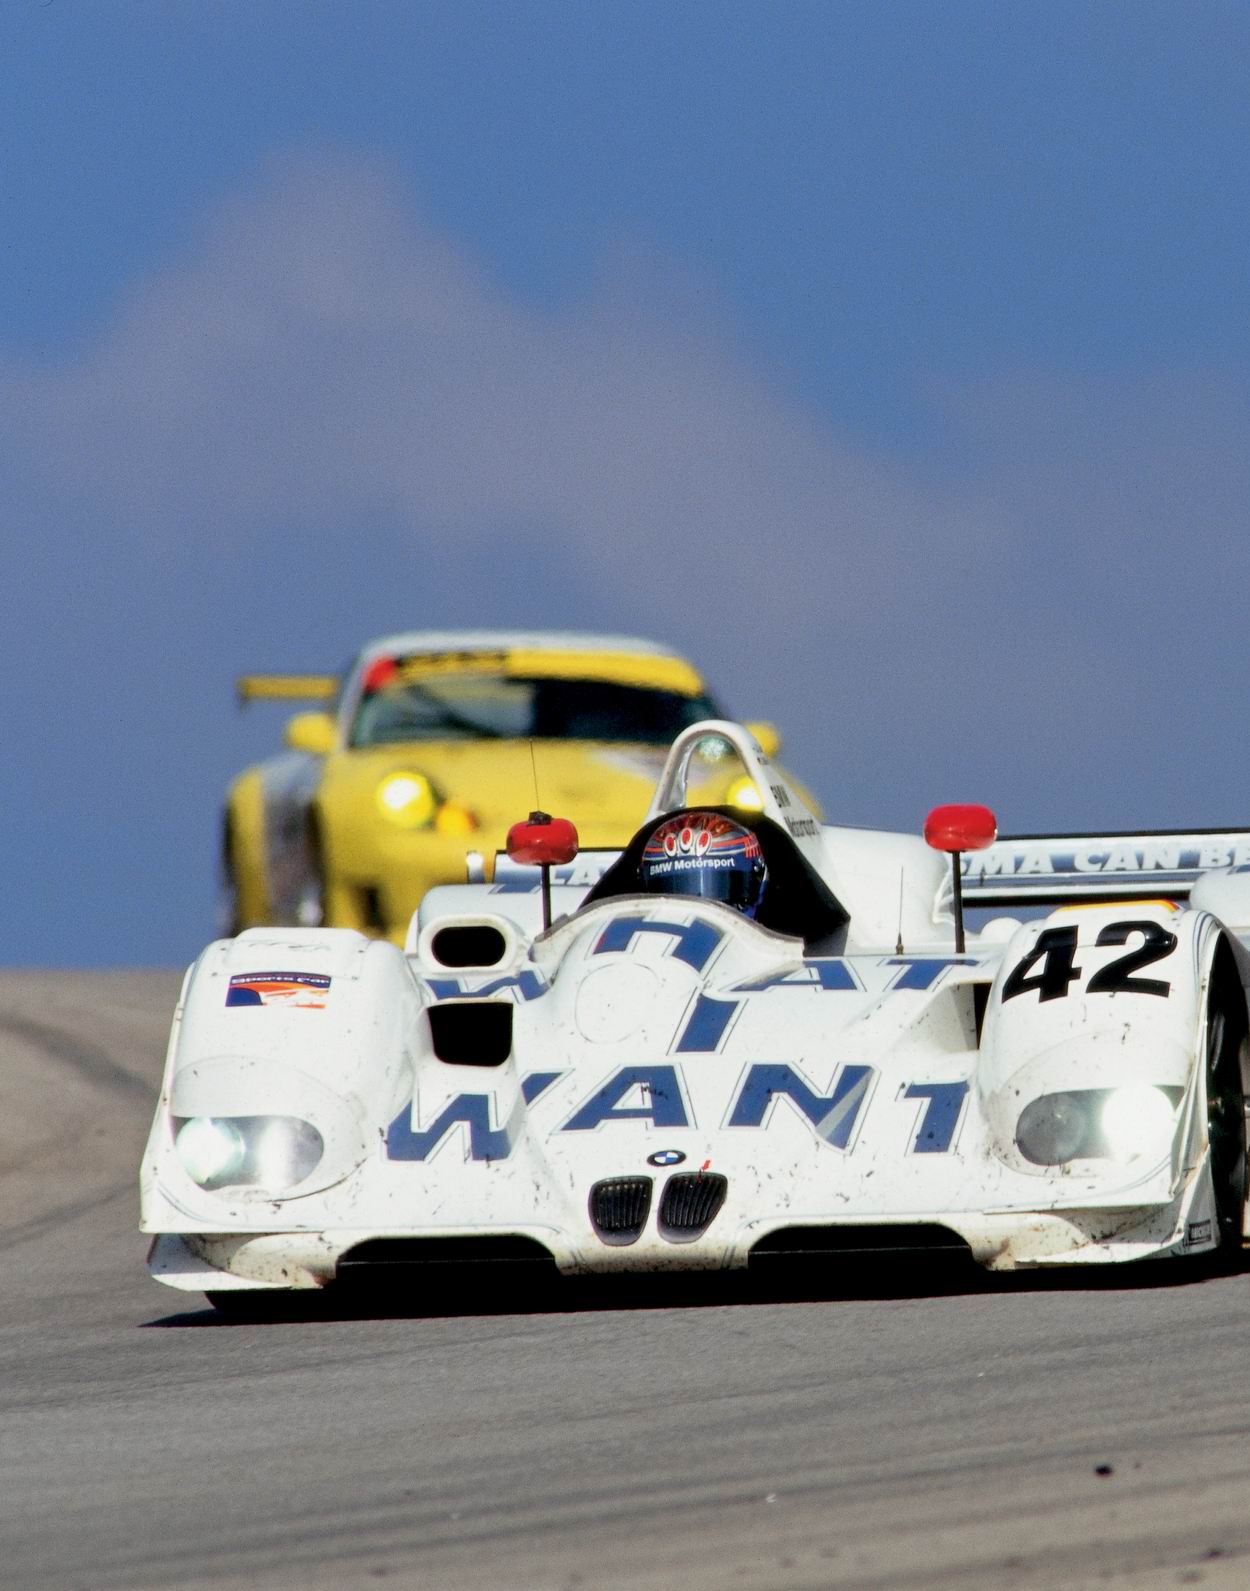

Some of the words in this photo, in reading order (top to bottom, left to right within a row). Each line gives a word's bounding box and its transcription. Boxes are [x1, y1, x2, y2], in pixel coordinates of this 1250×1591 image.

[650, 861, 672, 876] BMW
[674, 857, 735, 871] Motorsport
[1074, 844, 1181, 872] CAN
[1002, 919, 1178, 1003] 42
[386, 1062, 972, 1162] WANT
